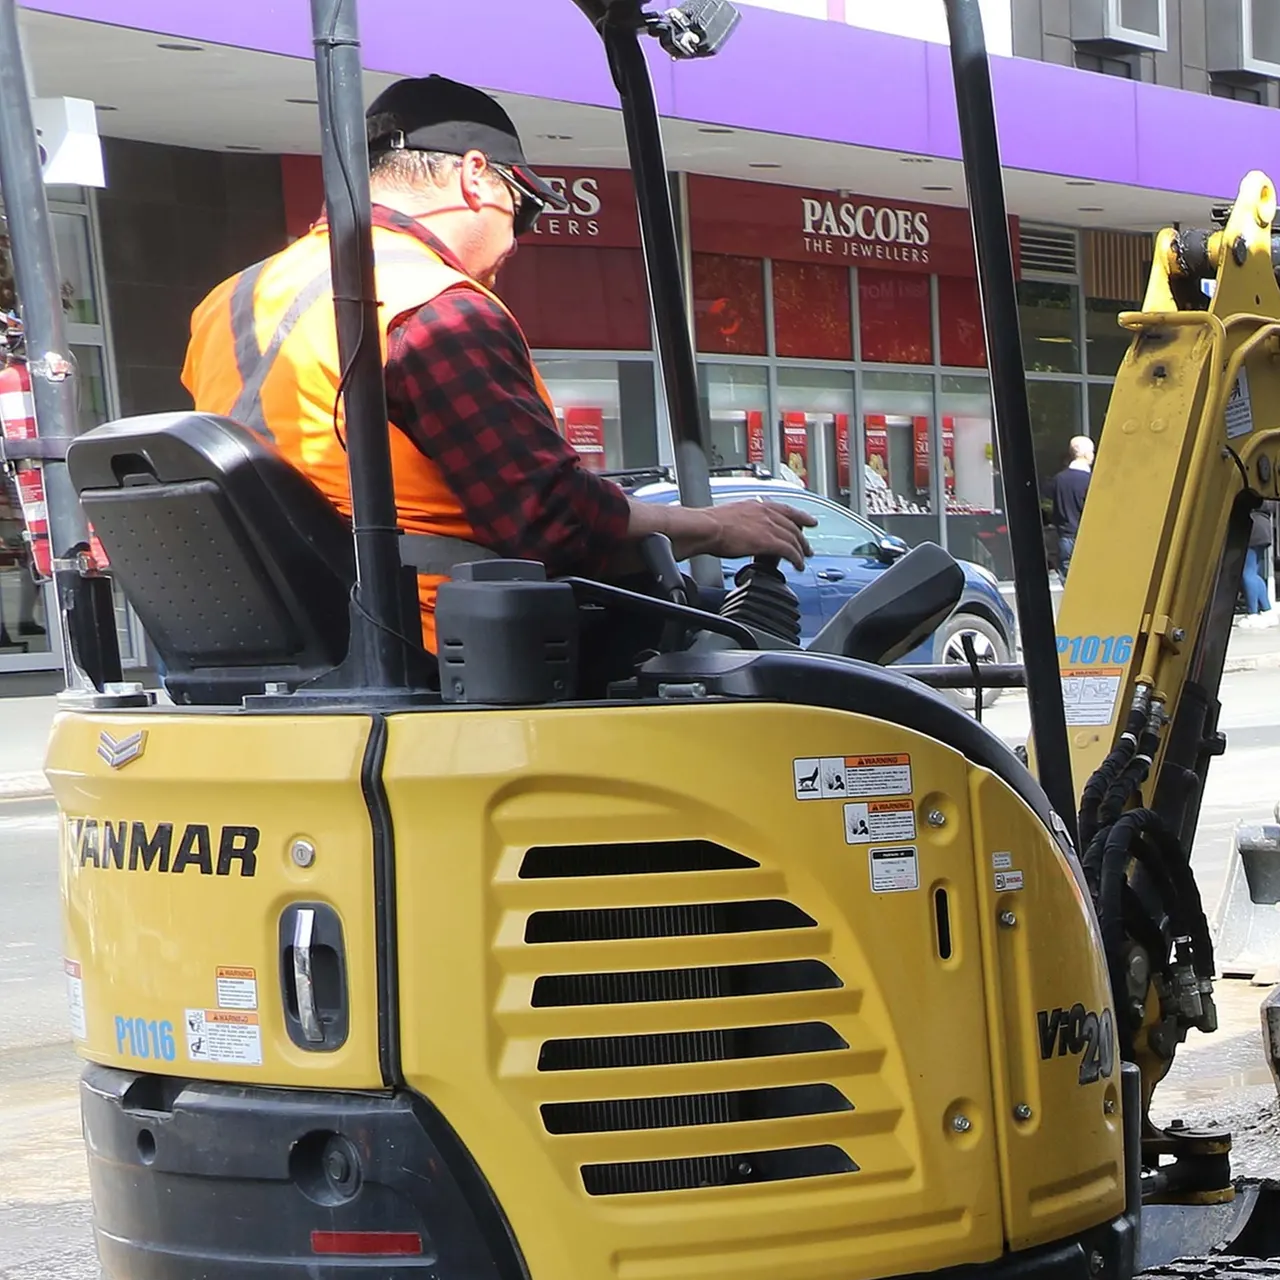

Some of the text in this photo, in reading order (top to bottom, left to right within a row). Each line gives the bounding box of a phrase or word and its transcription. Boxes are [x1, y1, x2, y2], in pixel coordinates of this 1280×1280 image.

[801, 198, 930, 246] PASCOES
[803, 238, 930, 264] THE JEWELLERS
[1056, 634, 1134, 664] P1016
[864, 756, 898, 765] WARNING
[878, 801, 910, 811] WARNING
[68, 818, 260, 877] YANMAR
[115, 1015, 176, 1062] P1016
